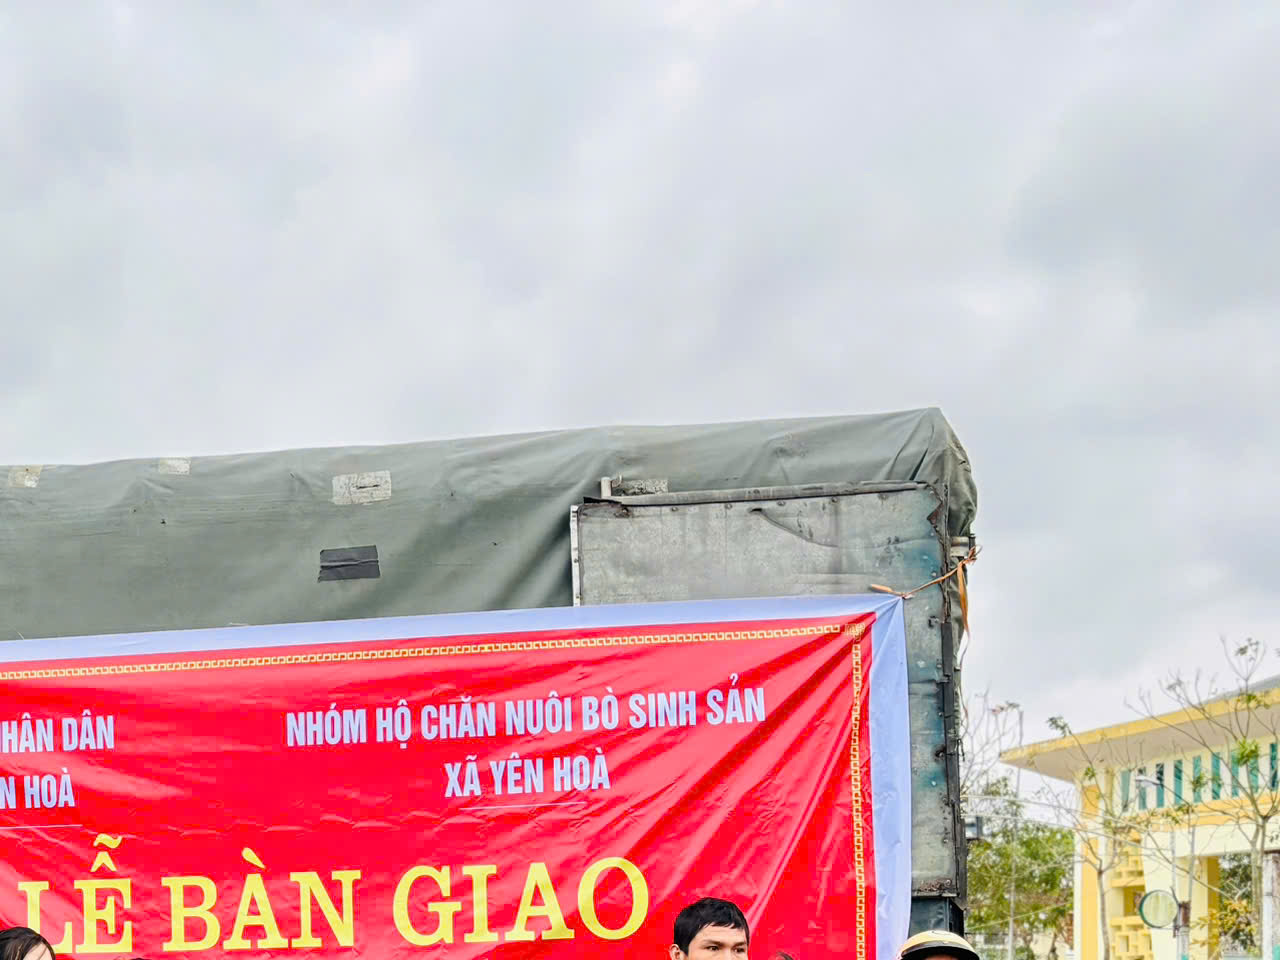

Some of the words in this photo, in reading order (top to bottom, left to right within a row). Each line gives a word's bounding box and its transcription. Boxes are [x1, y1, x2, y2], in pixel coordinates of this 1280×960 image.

[61, 709, 115, 751] DÂN
[286, 703, 367, 747] NHÓM
[375, 699, 412, 749] HỘ
[420, 696, 496, 740] CHĂN
[505, 690, 572, 736] NUÔI
[581, 686, 619, 731] BÒ
[628, 690, 697, 729] SINH
[706, 672, 766, 725] SẢN
[23, 767, 75, 809] HOÀ
[444, 754, 482, 798] XÃ
[489, 751, 544, 794] YÊN
[553, 747, 610, 792] HOÀ
[17, 833, 133, 955] LỄ
[161, 847, 362, 952] BÀN
[392, 856, 649, 946] GIAO
